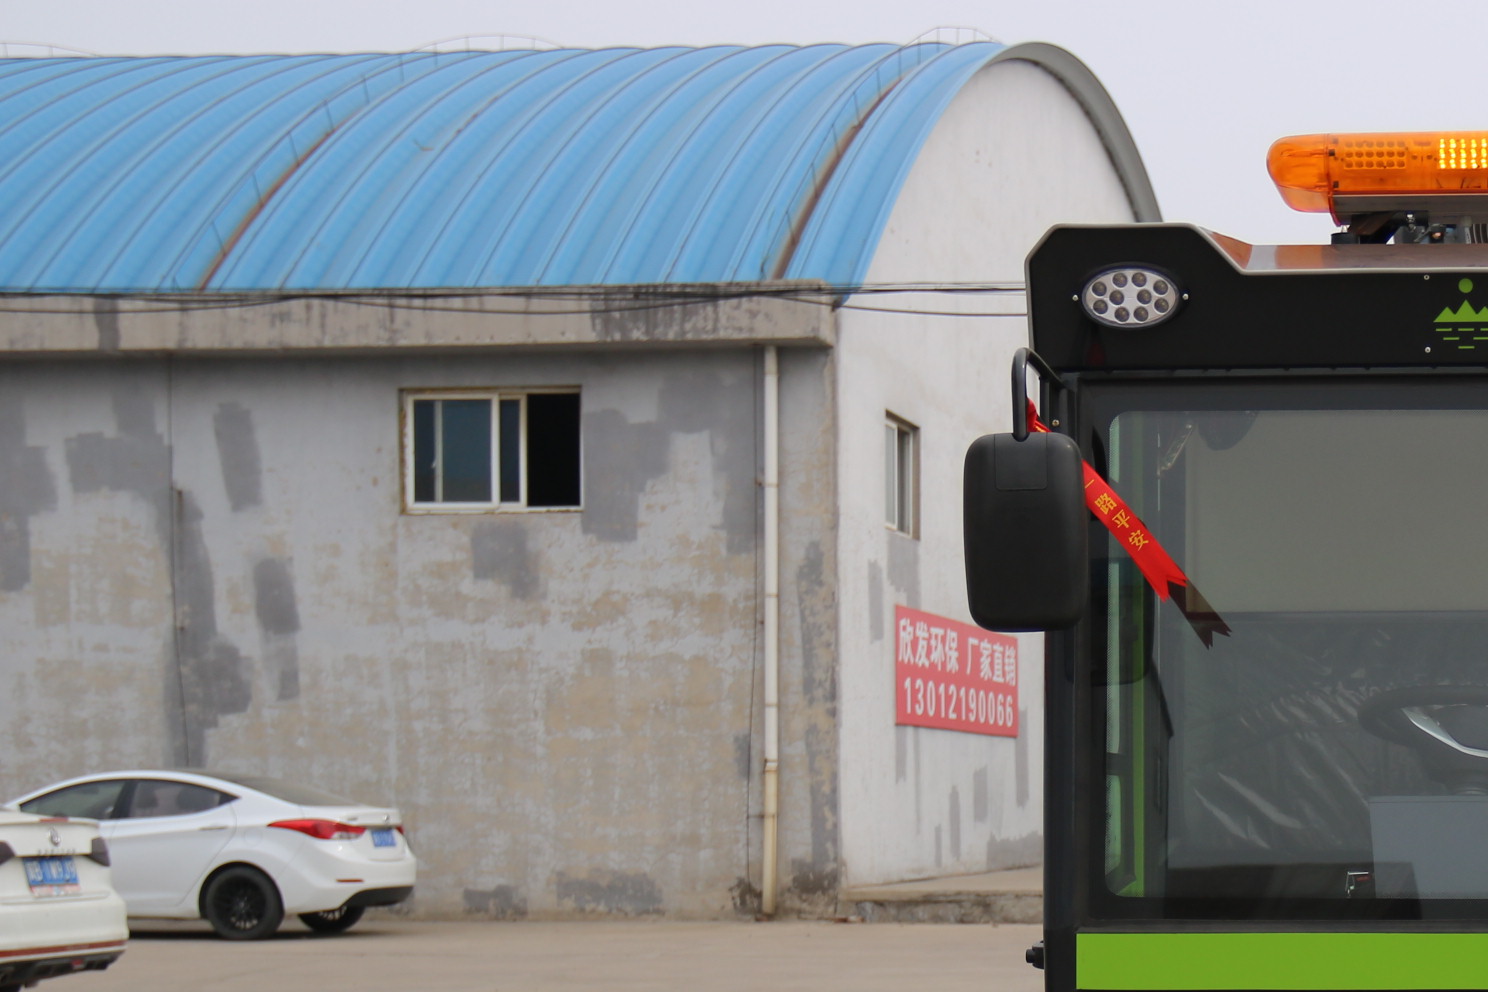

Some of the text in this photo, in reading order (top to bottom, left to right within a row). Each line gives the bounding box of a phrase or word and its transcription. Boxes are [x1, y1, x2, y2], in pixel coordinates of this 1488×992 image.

[1084, 479, 1149, 551] 一路平安
[898, 617, 959, 674] 欣发环保
[904, 676, 1013, 728] 13012190066
